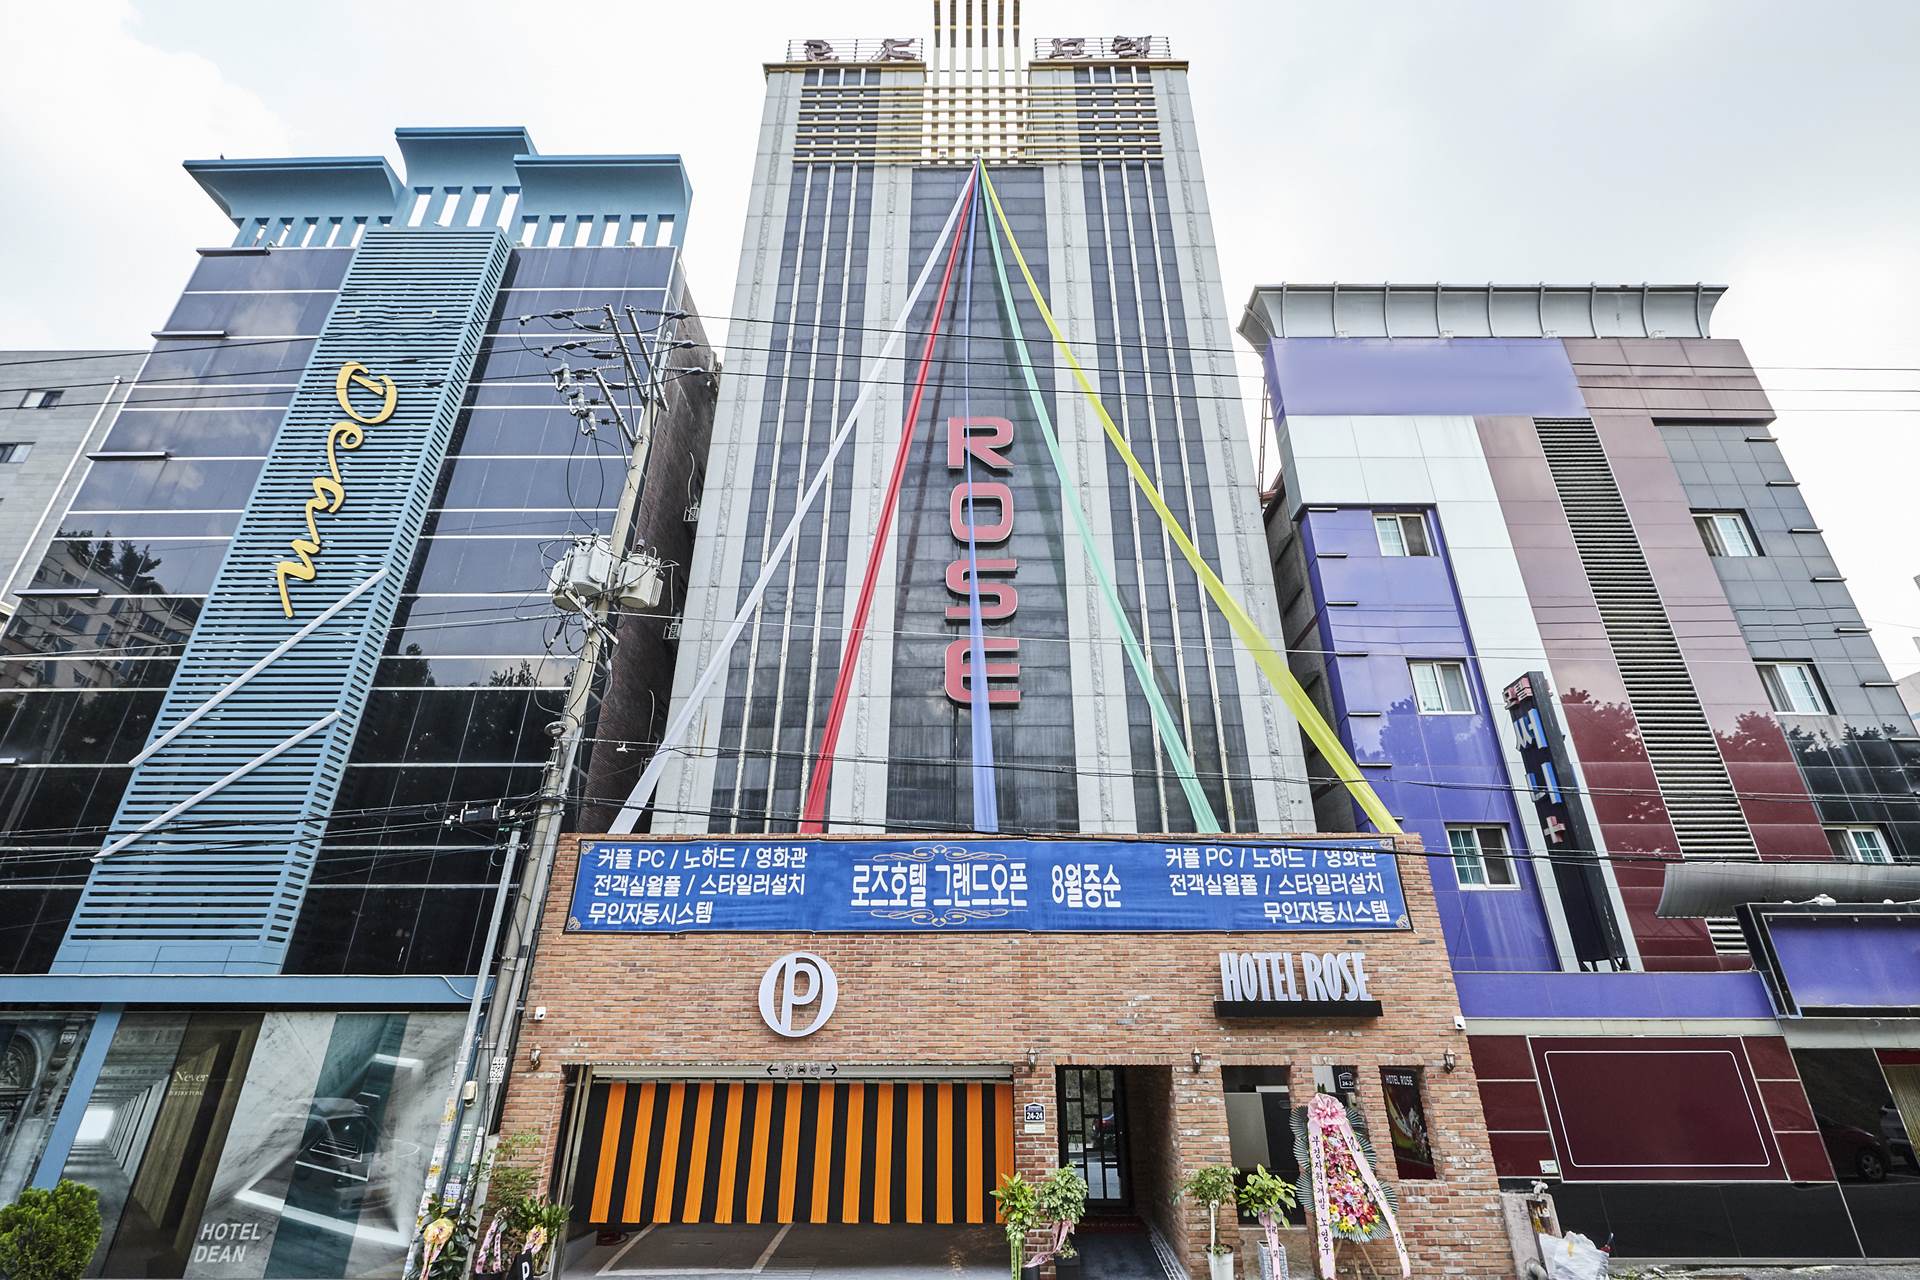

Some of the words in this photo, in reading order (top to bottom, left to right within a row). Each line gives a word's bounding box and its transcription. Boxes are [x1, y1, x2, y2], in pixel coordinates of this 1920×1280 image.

[944, 416, 1021, 703] ROSE
[598, 848, 632, 869] 커플
[637, 849, 665, 868] PC
[684, 847, 735, 869] 노하드
[756, 847, 807, 869] 영화관
[1166, 848, 1200, 869] 커플
[1206, 848, 1233, 867] PC
[1253, 848, 1304, 868] 노하드
[1324, 846, 1376, 868] 영화관
[594, 874, 681, 896] 전객실월풀
[700, 873, 805, 895] 스타일러설치
[851, 862, 927, 907] 로즈호텔
[933, 862, 1028, 907] 그랜드오픈
[1052, 863, 1121, 908] 8월중순
[1169, 873, 1258, 896] 전객실월풀
[1278, 872, 1385, 895] 스타일러설치
[588, 901, 713, 925] 무인자동시스템
[1263, 900, 1390, 924] 무인자동시스템
[1219, 952, 1302, 1001] HOTEL
[1301, 952, 1374, 1001] ROSE
[1385, 1074, 1400, 1085] HOTEL
[1400, 1075, 1413, 1086] ROSE
[1026, 1112, 1043, 1120] 24-24
[201, 1223, 261, 1240] HOTEL
[194, 1245, 247, 1263] DEAN
